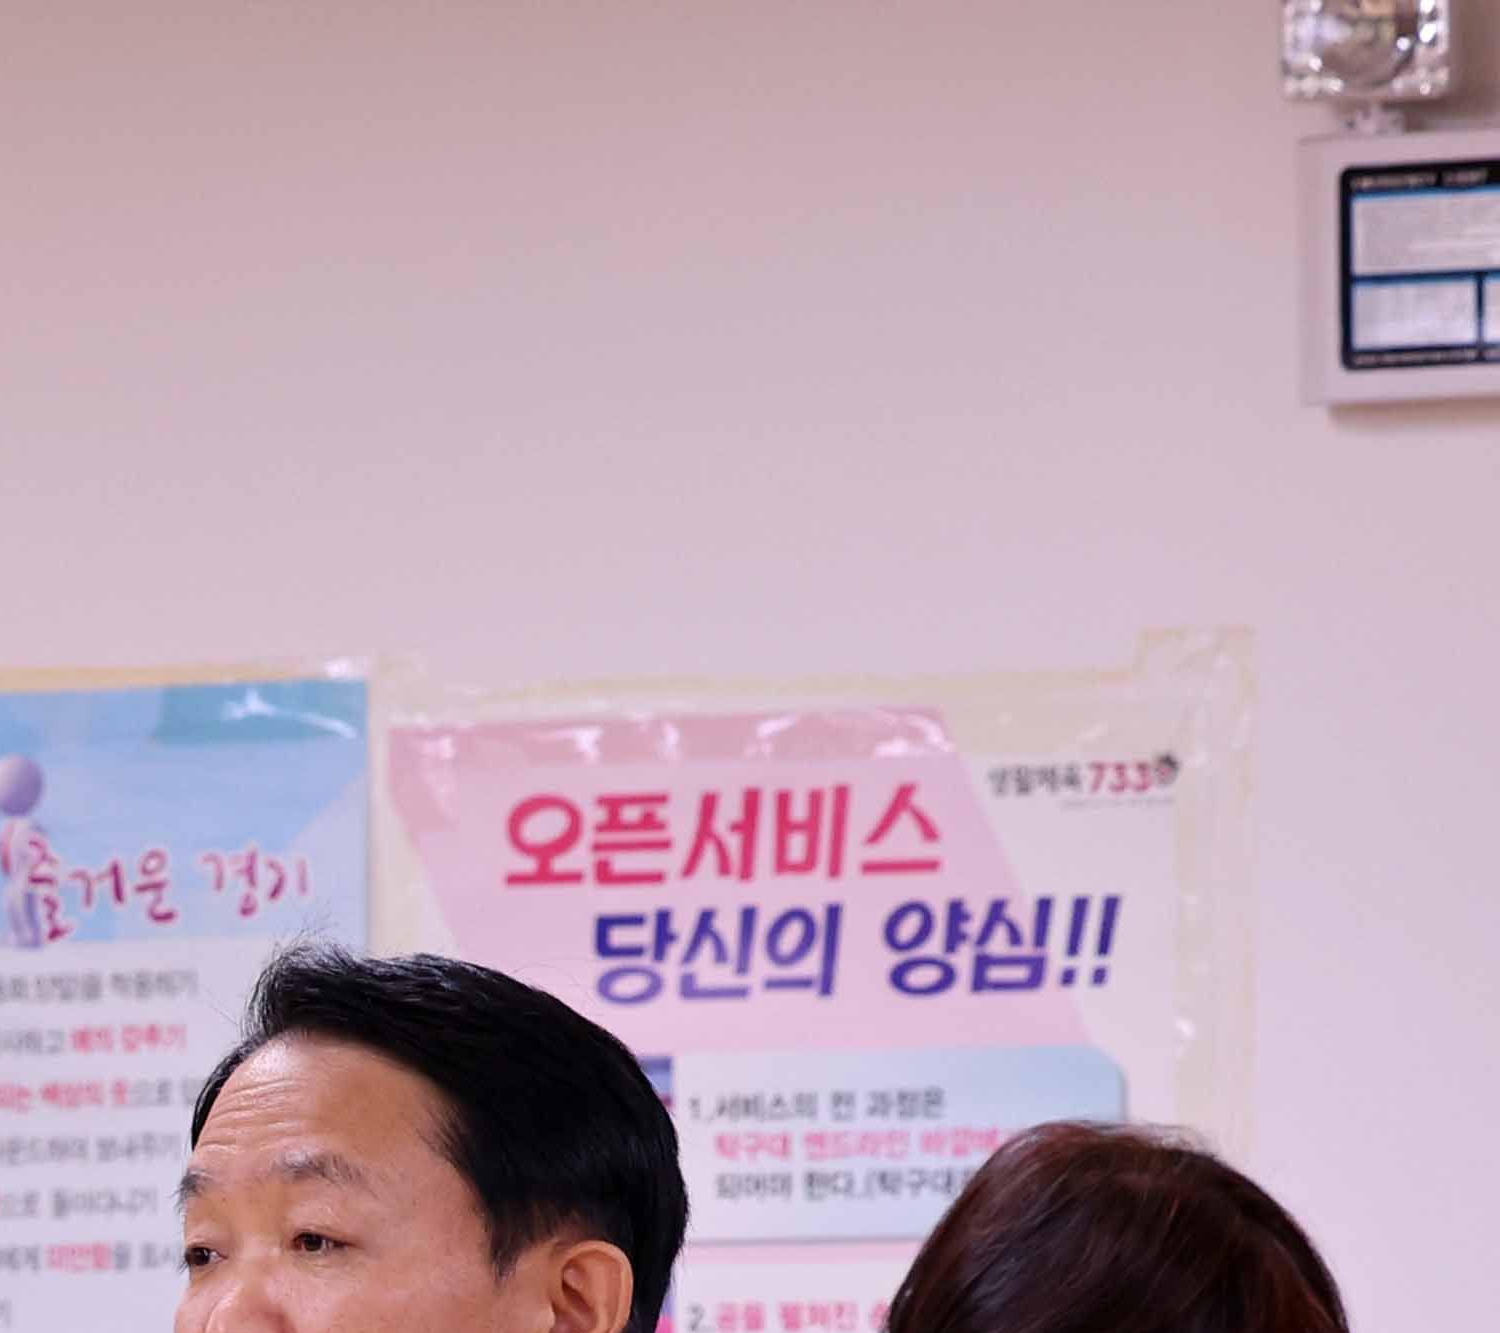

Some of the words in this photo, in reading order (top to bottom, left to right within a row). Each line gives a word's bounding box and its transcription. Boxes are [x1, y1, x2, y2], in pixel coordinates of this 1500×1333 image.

[204, 850, 312, 921] 경기
[505, 784, 942, 887] 오픈서비스
[593, 904, 844, 1004] 당신의
[882, 895, 1122, 996] 양심!!
